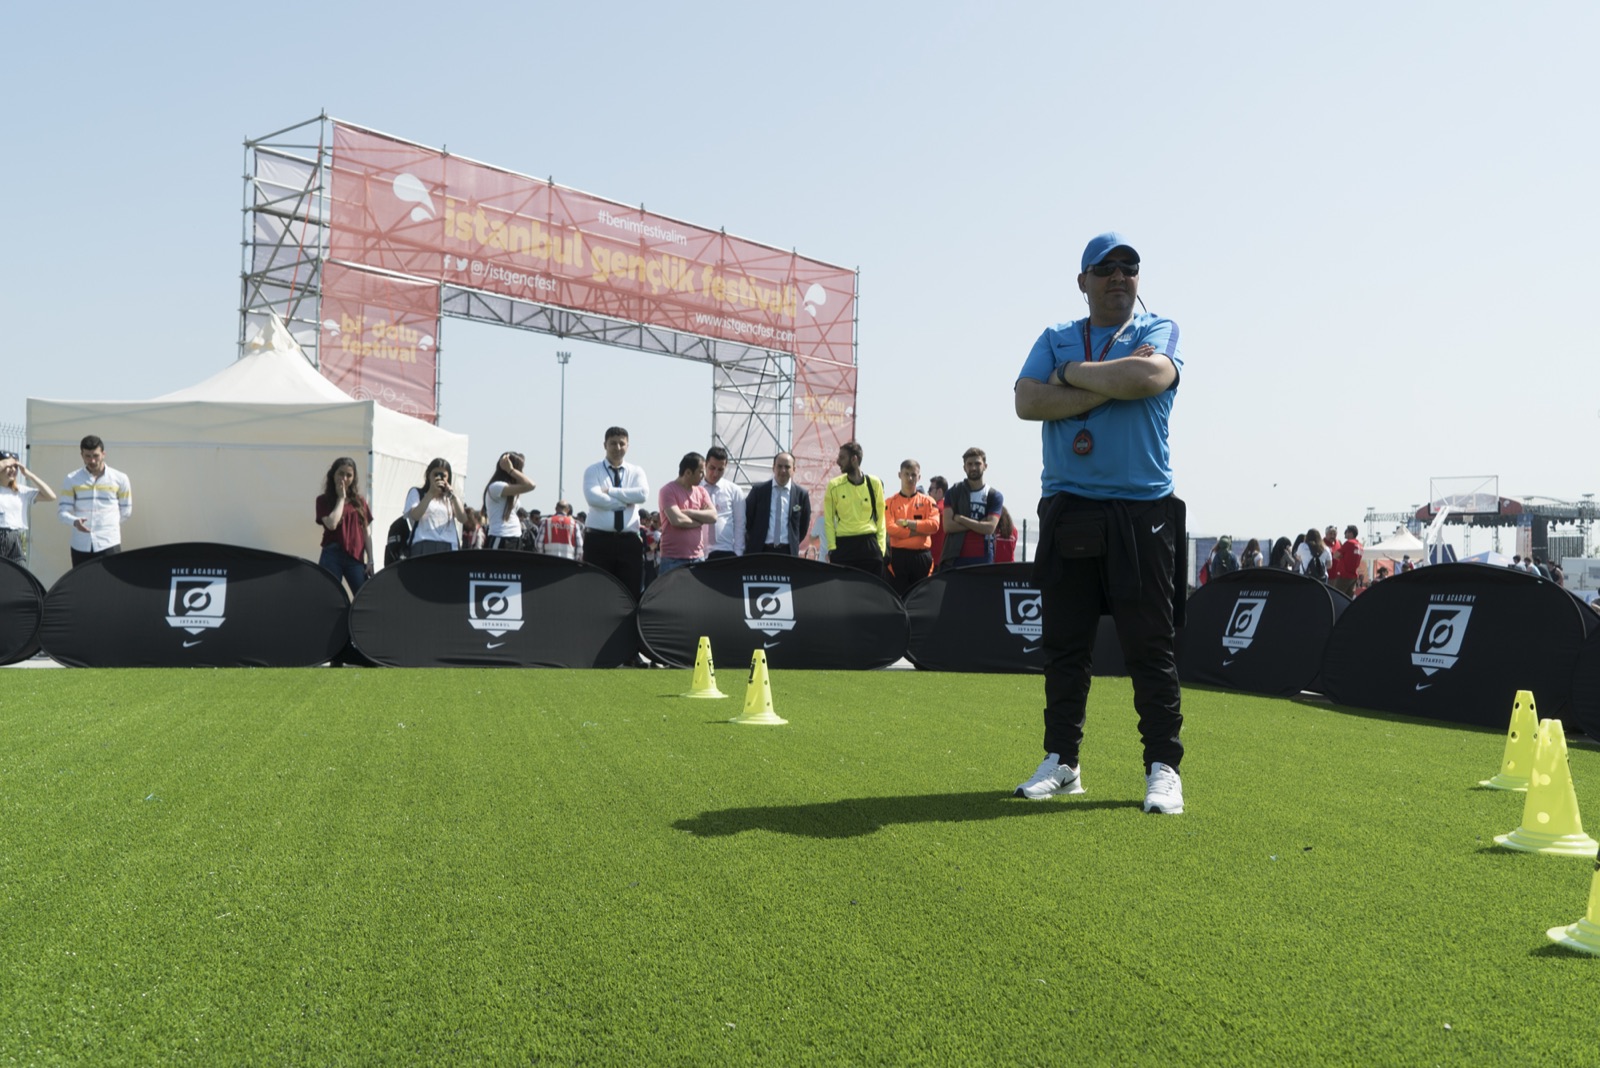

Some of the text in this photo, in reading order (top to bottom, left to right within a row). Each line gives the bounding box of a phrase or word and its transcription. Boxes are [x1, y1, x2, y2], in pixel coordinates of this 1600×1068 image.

[598, 209, 687, 246] #benimfestivalim
[444, 199, 797, 318] istanbul gençlik festivali
[372, 319, 418, 343] dolu
[695, 312, 797, 342] www.istgencfest.com
[341, 334, 417, 364] festival
[1430, 594, 1476, 603] NIKE ACADEMY
